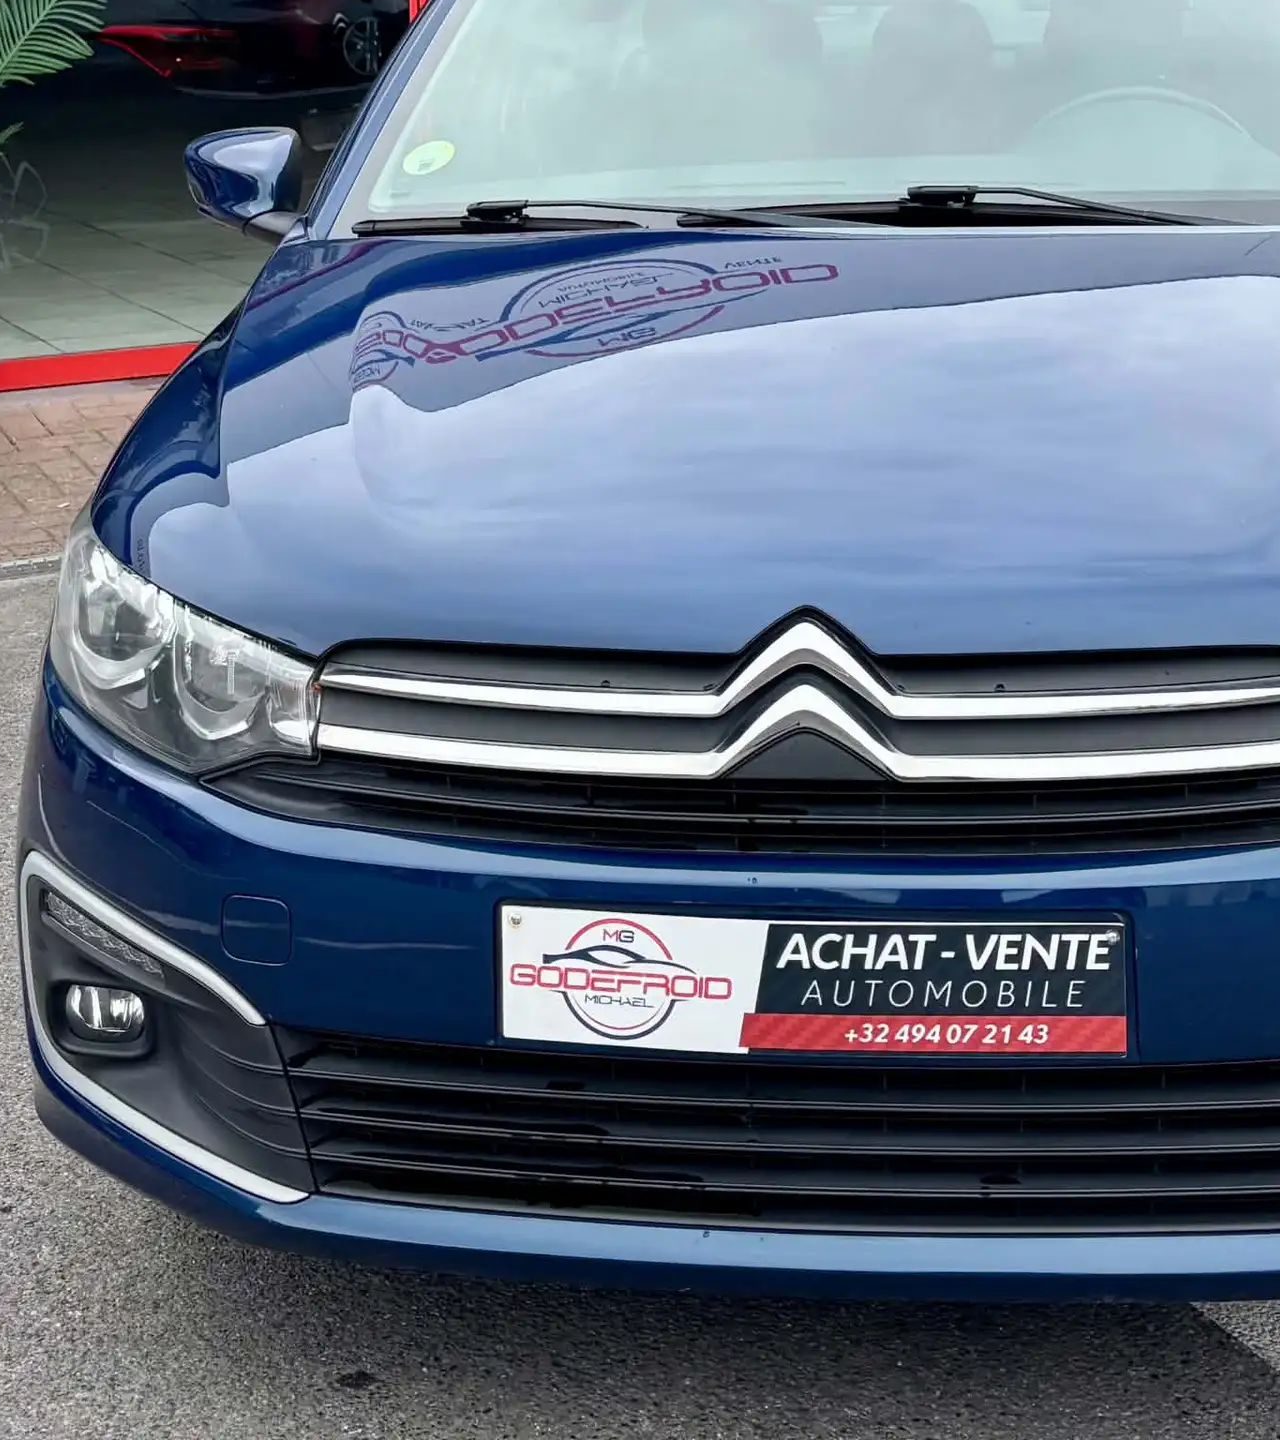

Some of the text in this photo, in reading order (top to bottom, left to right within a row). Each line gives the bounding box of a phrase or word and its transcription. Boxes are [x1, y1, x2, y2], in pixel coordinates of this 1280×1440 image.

[603, 928, 635, 943] MG
[776, 933, 938, 970] ACHAT
[965, 933, 1113, 971] VENTE
[510, 963, 732, 1000] GODEFROID
[801, 980, 1086, 1008] AUTOMOBILE
[584, 994, 657, 1008] MICHAEL
[844, 1023, 1050, 1045] +32 494 07 21 43
